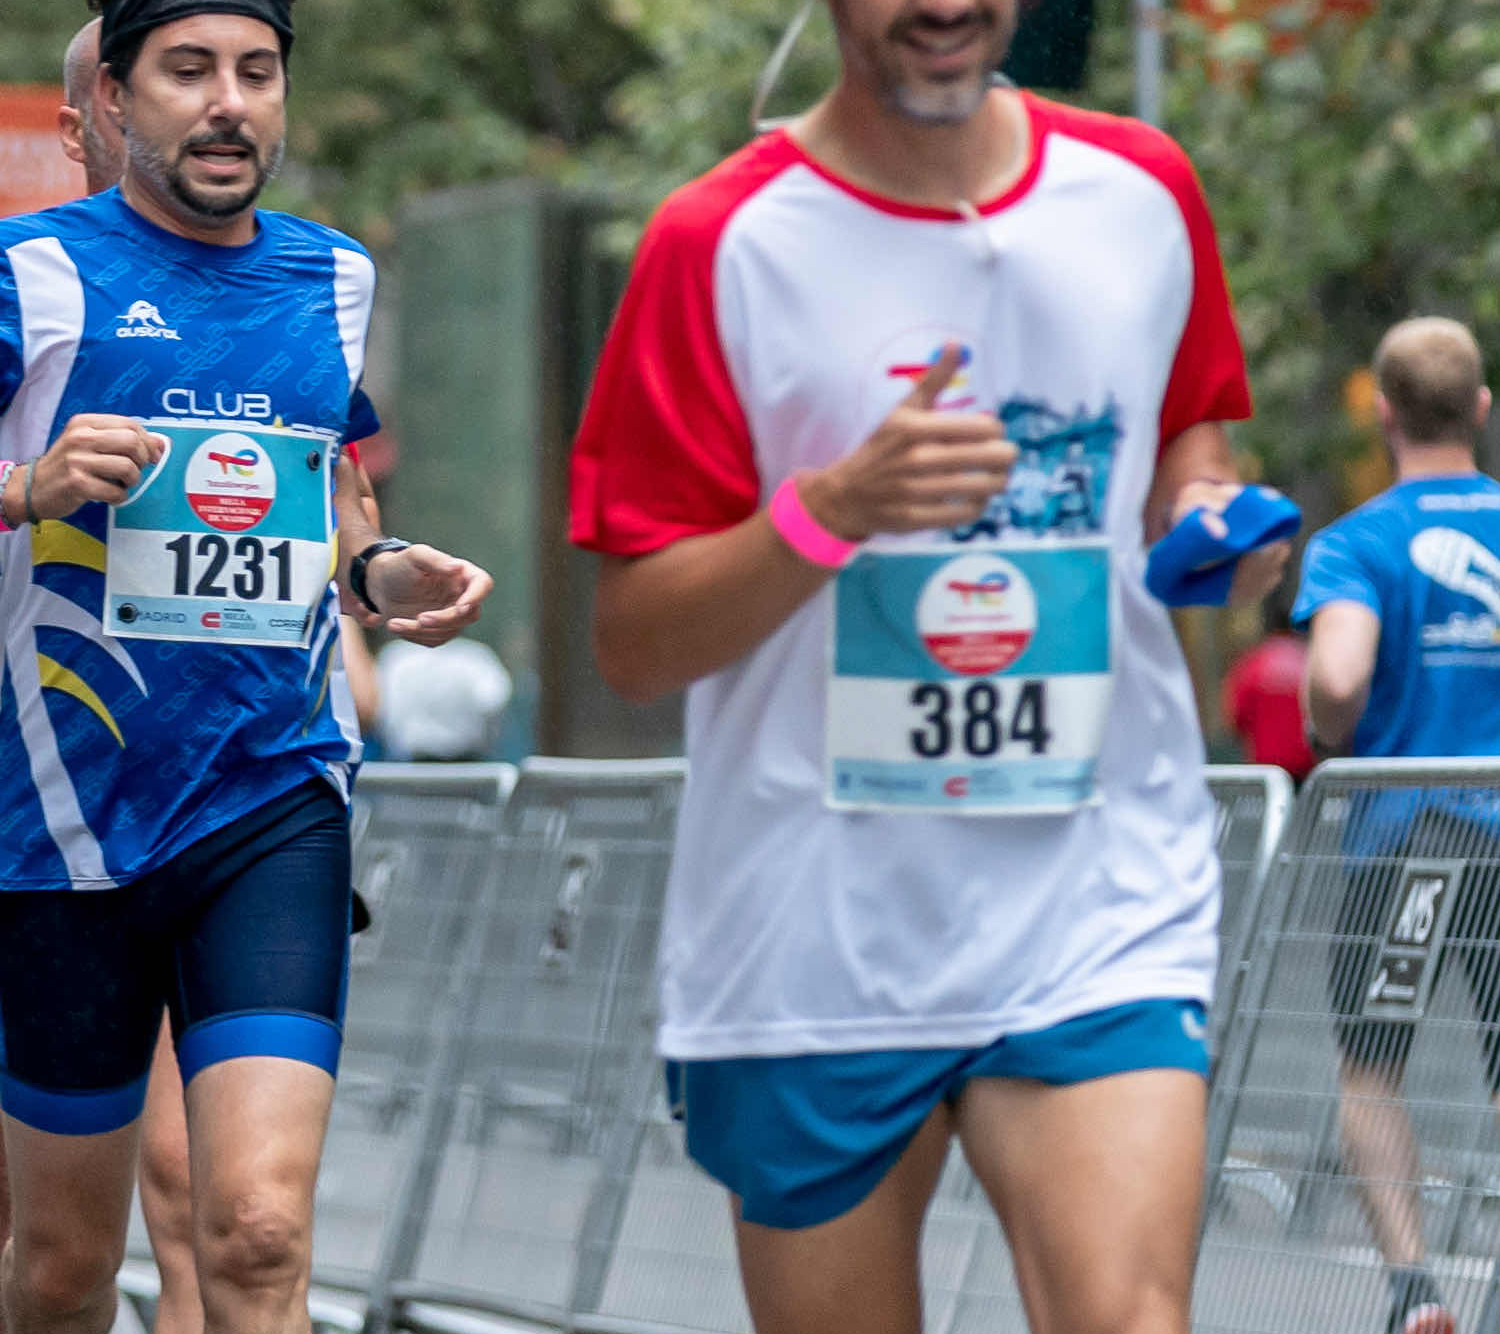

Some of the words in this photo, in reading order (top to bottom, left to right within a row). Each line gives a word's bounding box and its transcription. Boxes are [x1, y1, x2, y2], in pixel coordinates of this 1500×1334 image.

[162, 388, 271, 418] CLUB
[166, 534, 292, 601] 1231
[909, 681, 1051, 758] 384
